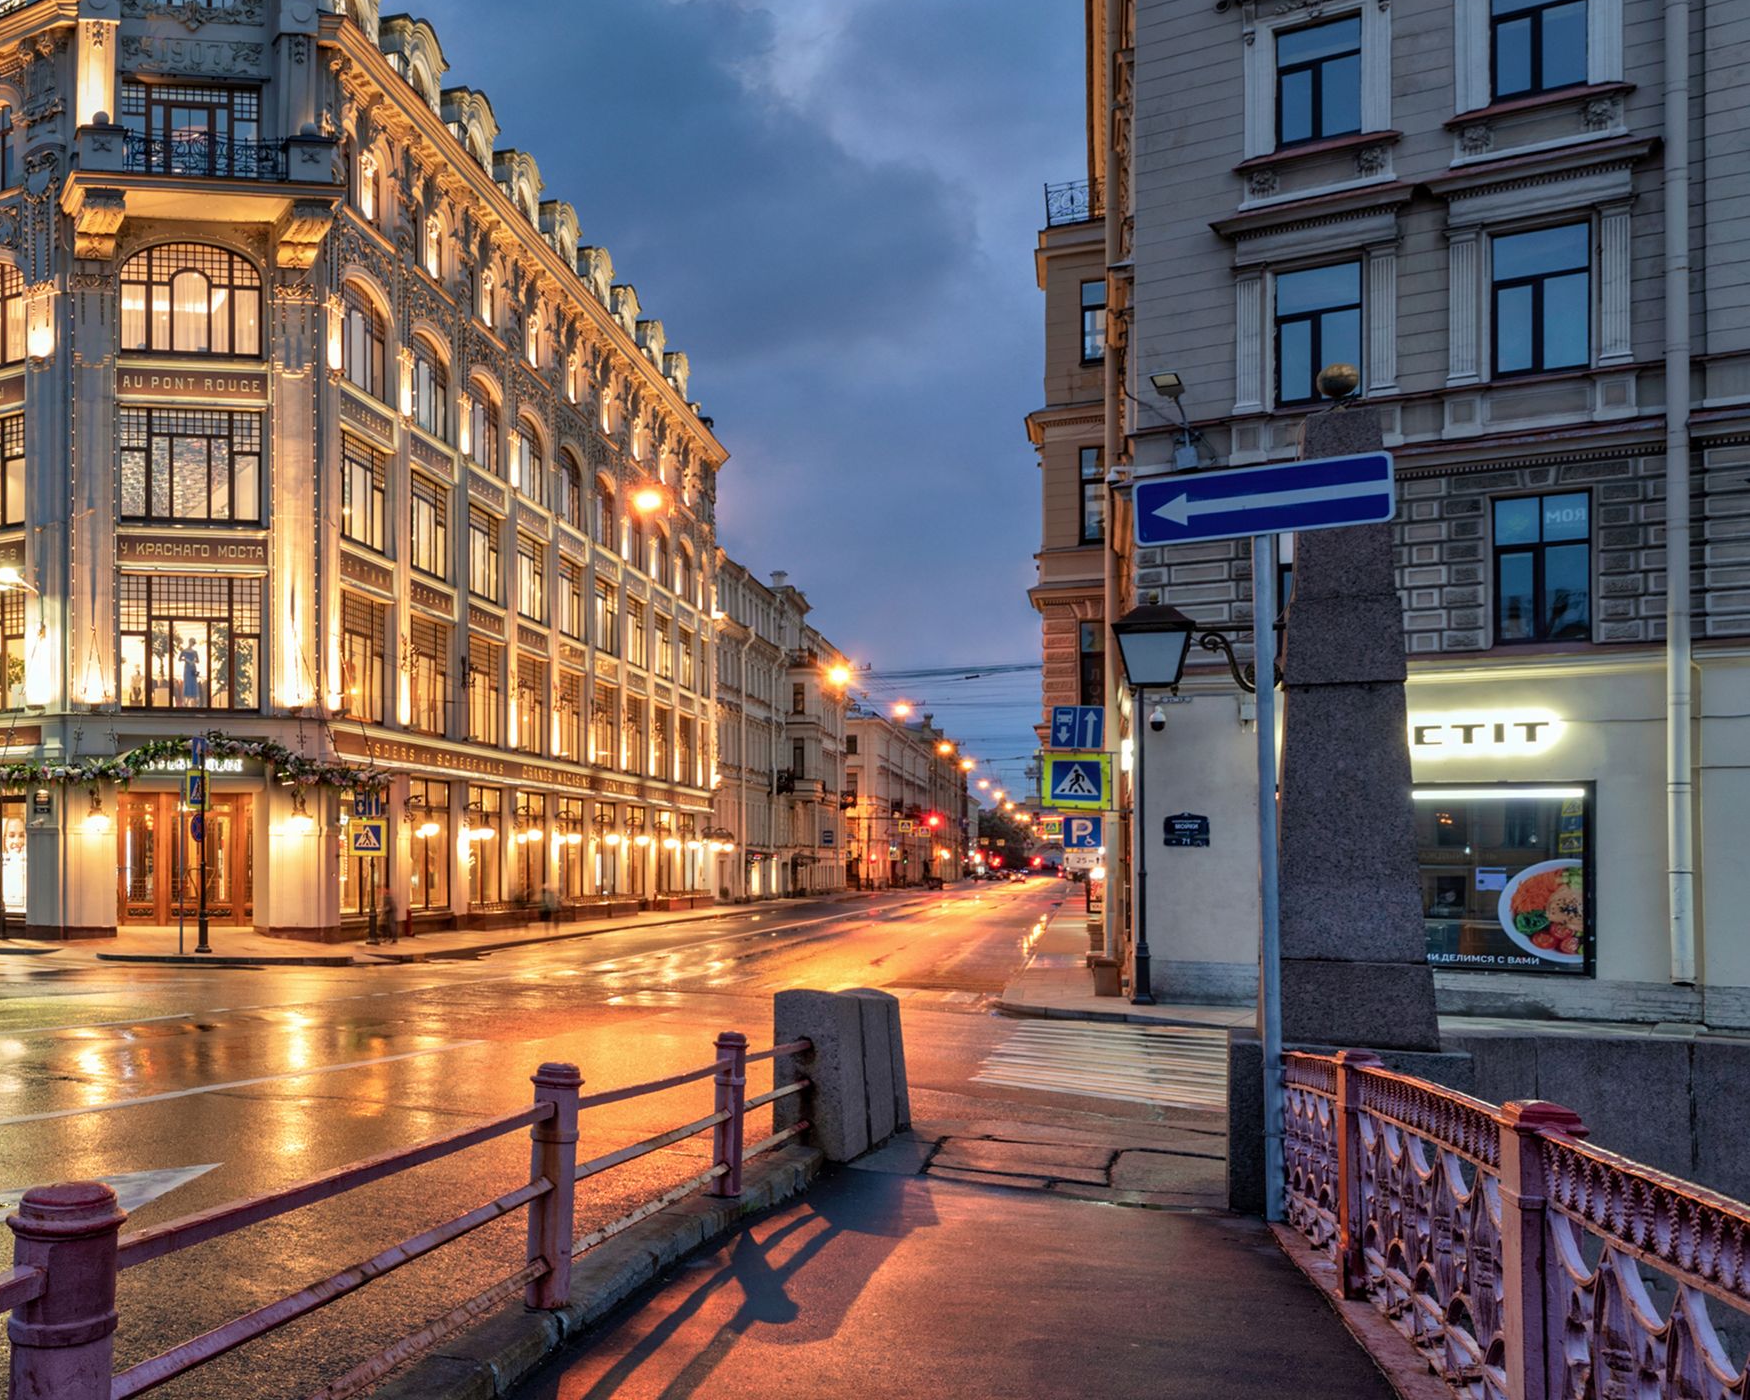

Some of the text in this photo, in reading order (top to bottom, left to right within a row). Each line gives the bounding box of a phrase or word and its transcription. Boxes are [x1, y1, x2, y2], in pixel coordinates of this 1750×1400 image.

[122, 375, 261, 393] AU PONT ROUGE
[120, 542, 265, 558] У КРАСНАГО МОСТА
[1441, 953, 1495, 963] ДЕЛИМСЯ
[1497, 955, 1504, 964] С
[1507, 956, 1540, 965] ВАМИ
